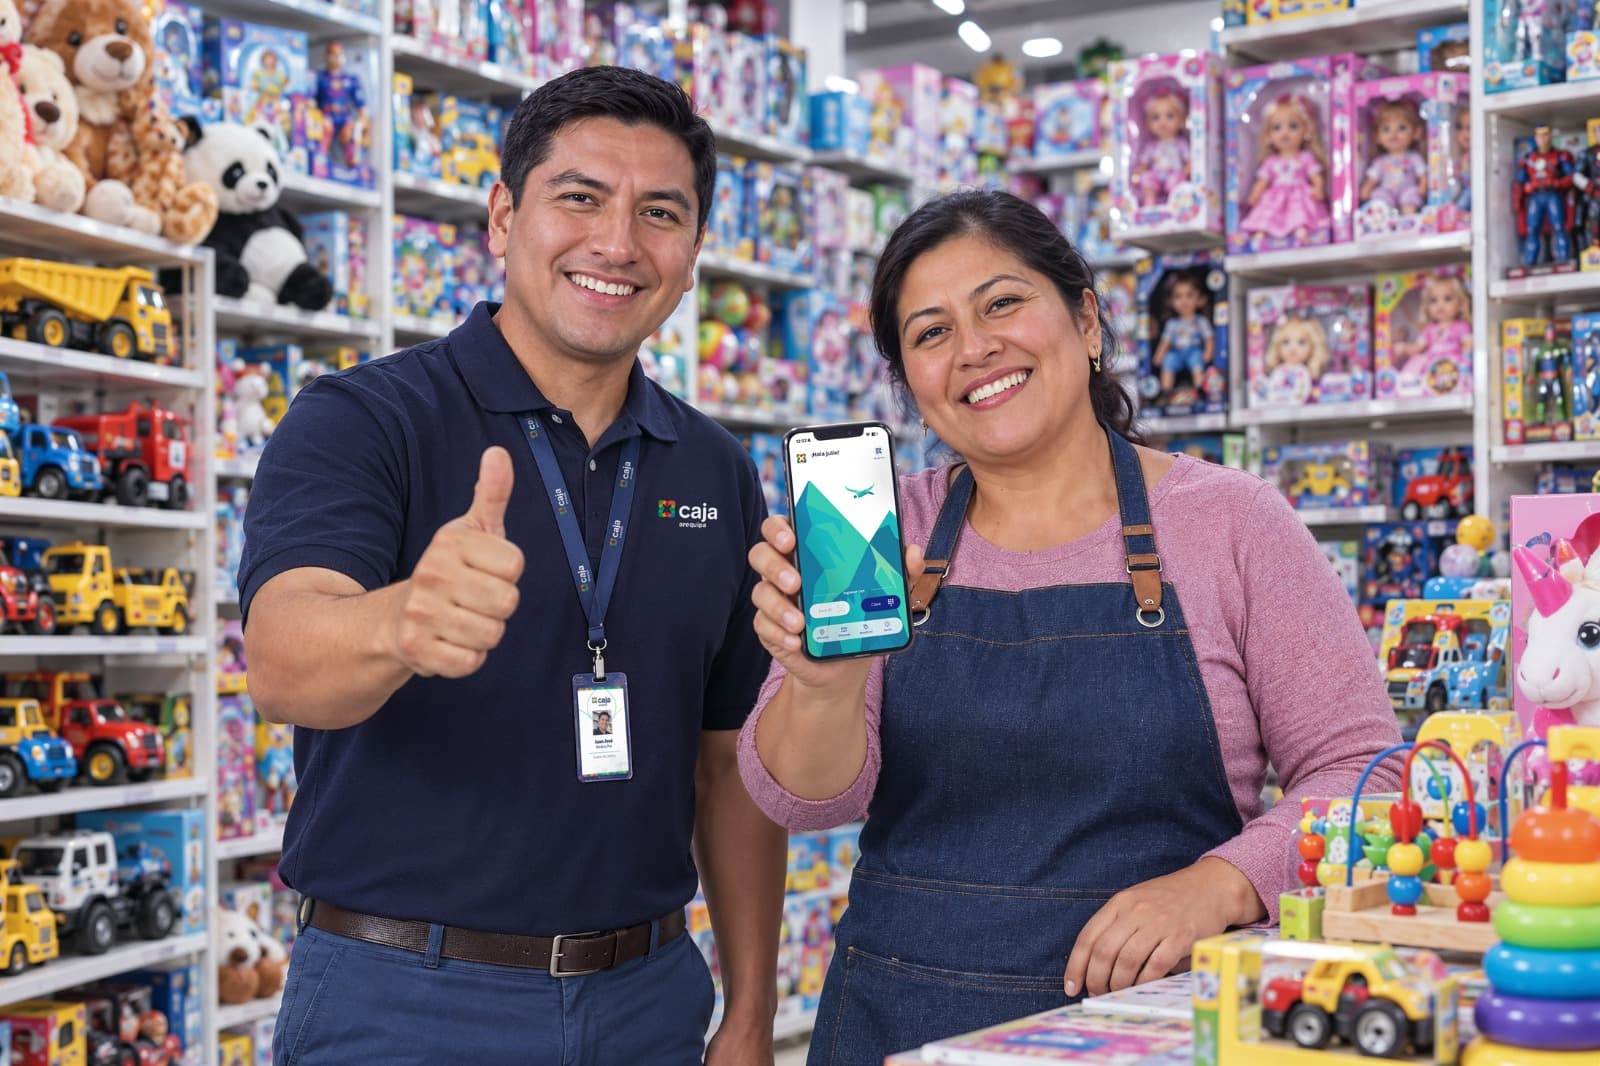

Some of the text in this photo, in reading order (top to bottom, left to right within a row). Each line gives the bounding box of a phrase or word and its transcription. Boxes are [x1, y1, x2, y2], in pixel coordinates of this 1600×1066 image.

[622, 461, 632, 480] caja
[554, 488, 565, 506] caja
[679, 502, 719, 522] caja
[612, 520, 621, 538] caja
[578, 565, 587, 583] caja
